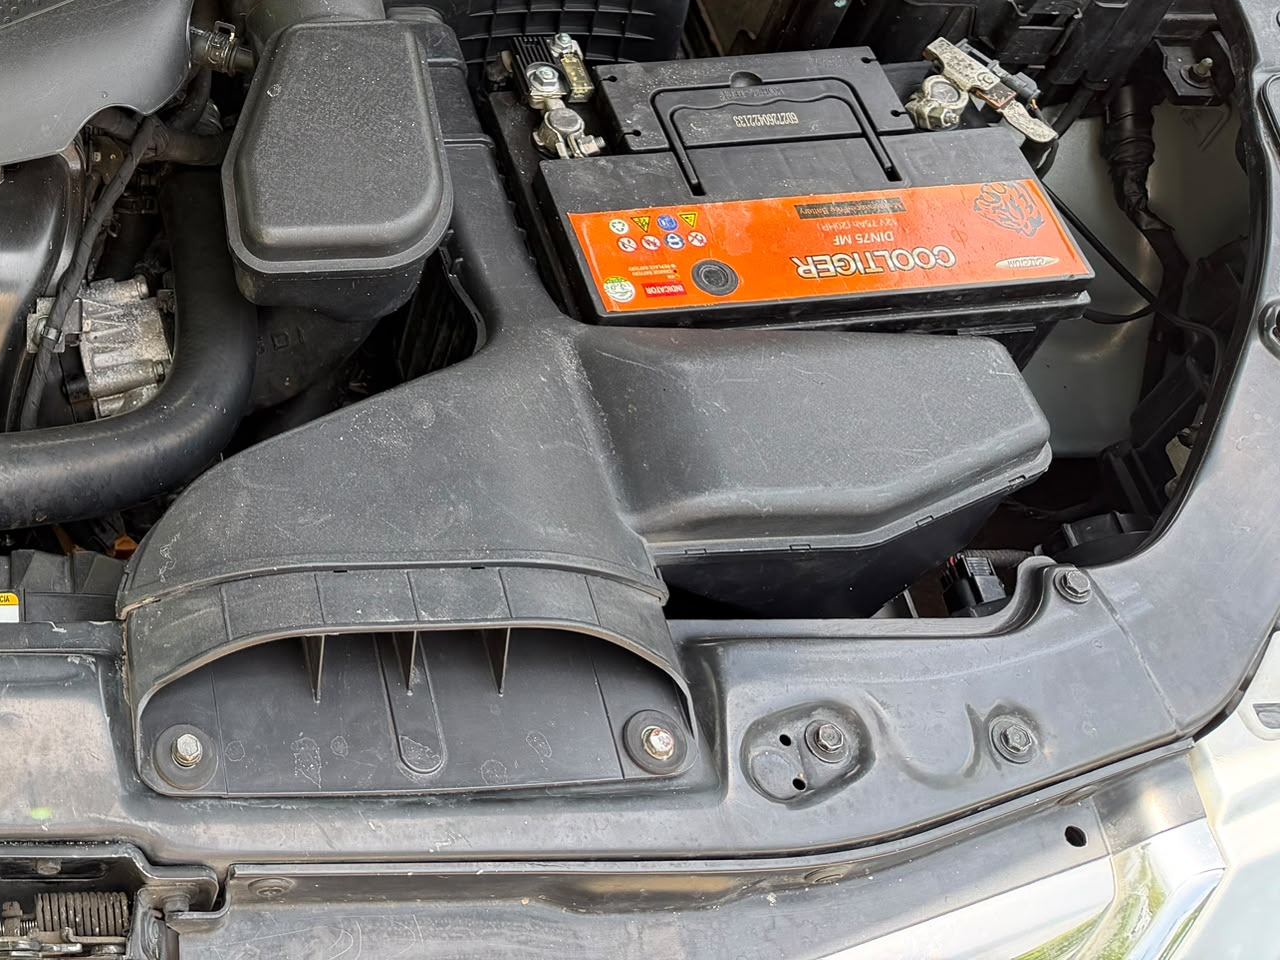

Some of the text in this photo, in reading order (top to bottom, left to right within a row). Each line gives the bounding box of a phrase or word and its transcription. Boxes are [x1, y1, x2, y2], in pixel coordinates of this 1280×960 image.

[833, 231, 895, 246] DIN75 MF
[789, 245, 957, 280] COOLTIGER
[1007, 257, 1045, 268] CALCIUM
[646, 284, 684, 295] INDICATOR
